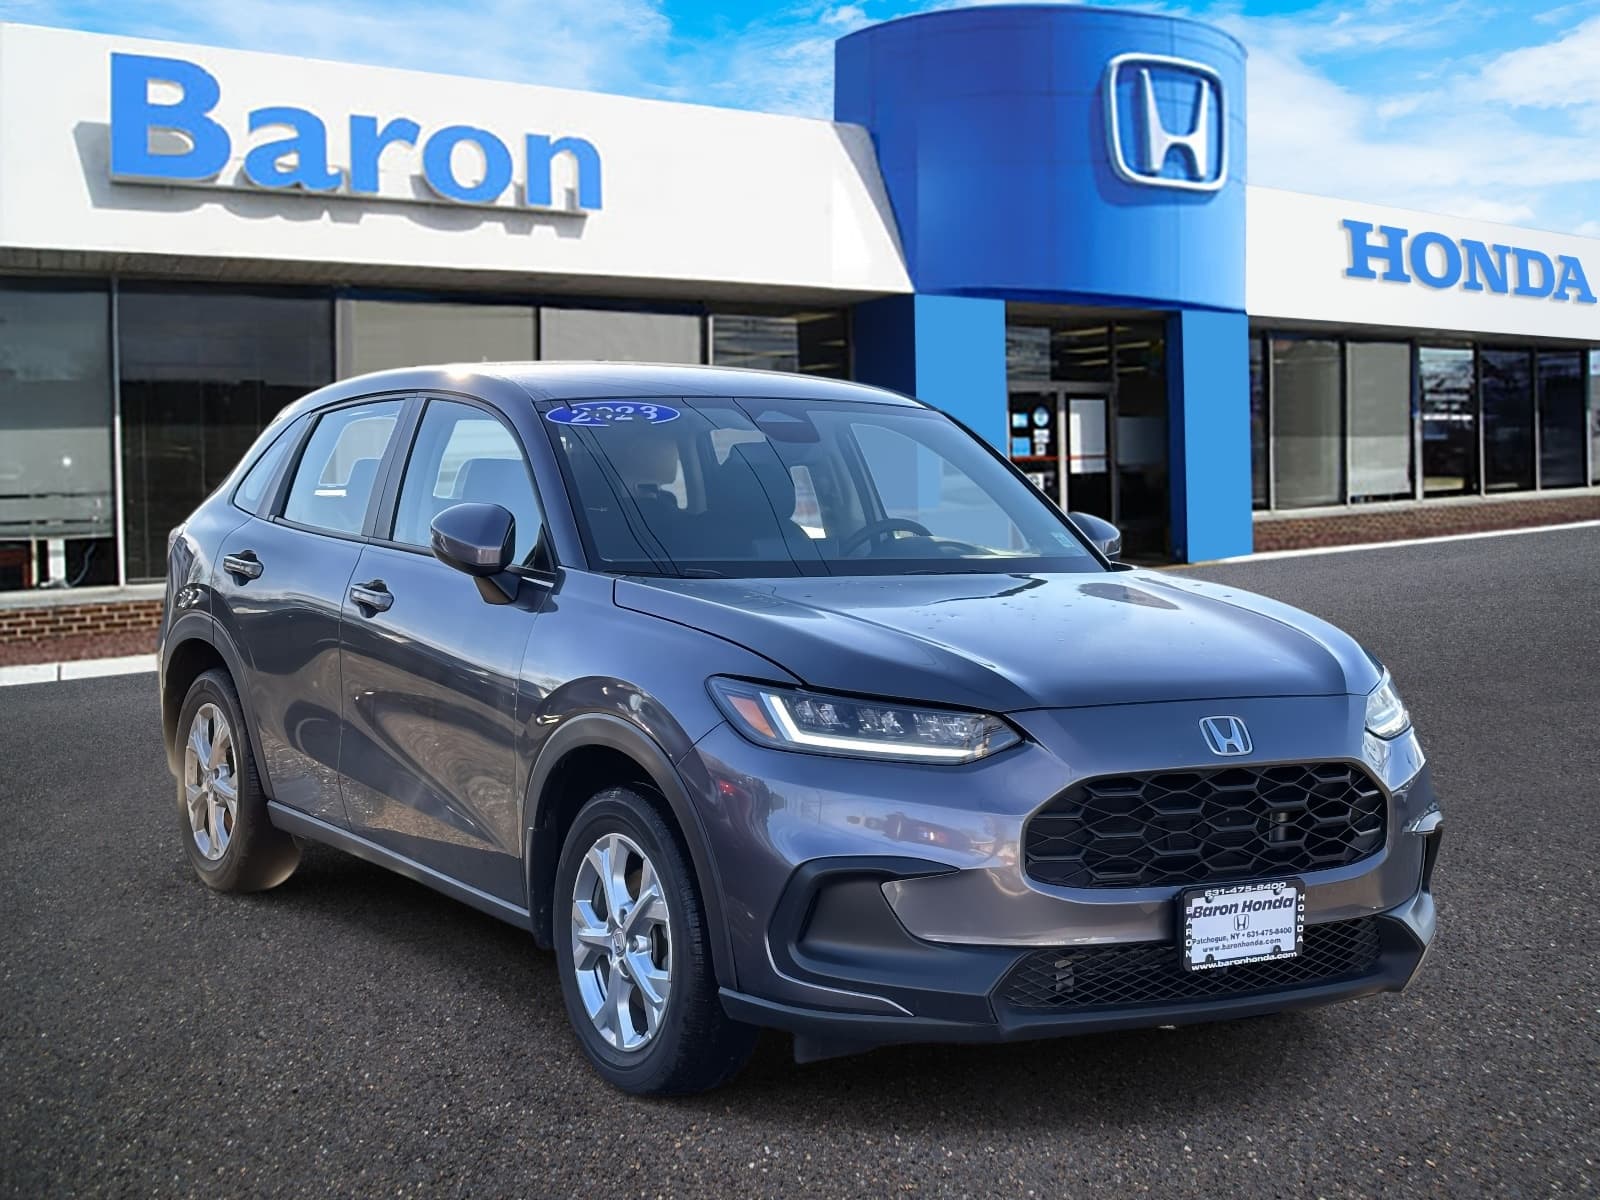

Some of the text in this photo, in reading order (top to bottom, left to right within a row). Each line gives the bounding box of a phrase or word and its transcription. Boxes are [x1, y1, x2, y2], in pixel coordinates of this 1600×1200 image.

[110, 52, 603, 211] Baron
[1342, 219, 1597, 304] HONDA
[1205, 882, 1287, 897] 631-475-8400
[1191, 896, 1294, 919] Baron Honda
[1296, 894, 1305, 943] HONDA
[1230, 932, 1240, 940] NY
[1246, 927, 1293, 938] 631-475-8400
[1191, 951, 1298, 971] www.baronhonda.com
